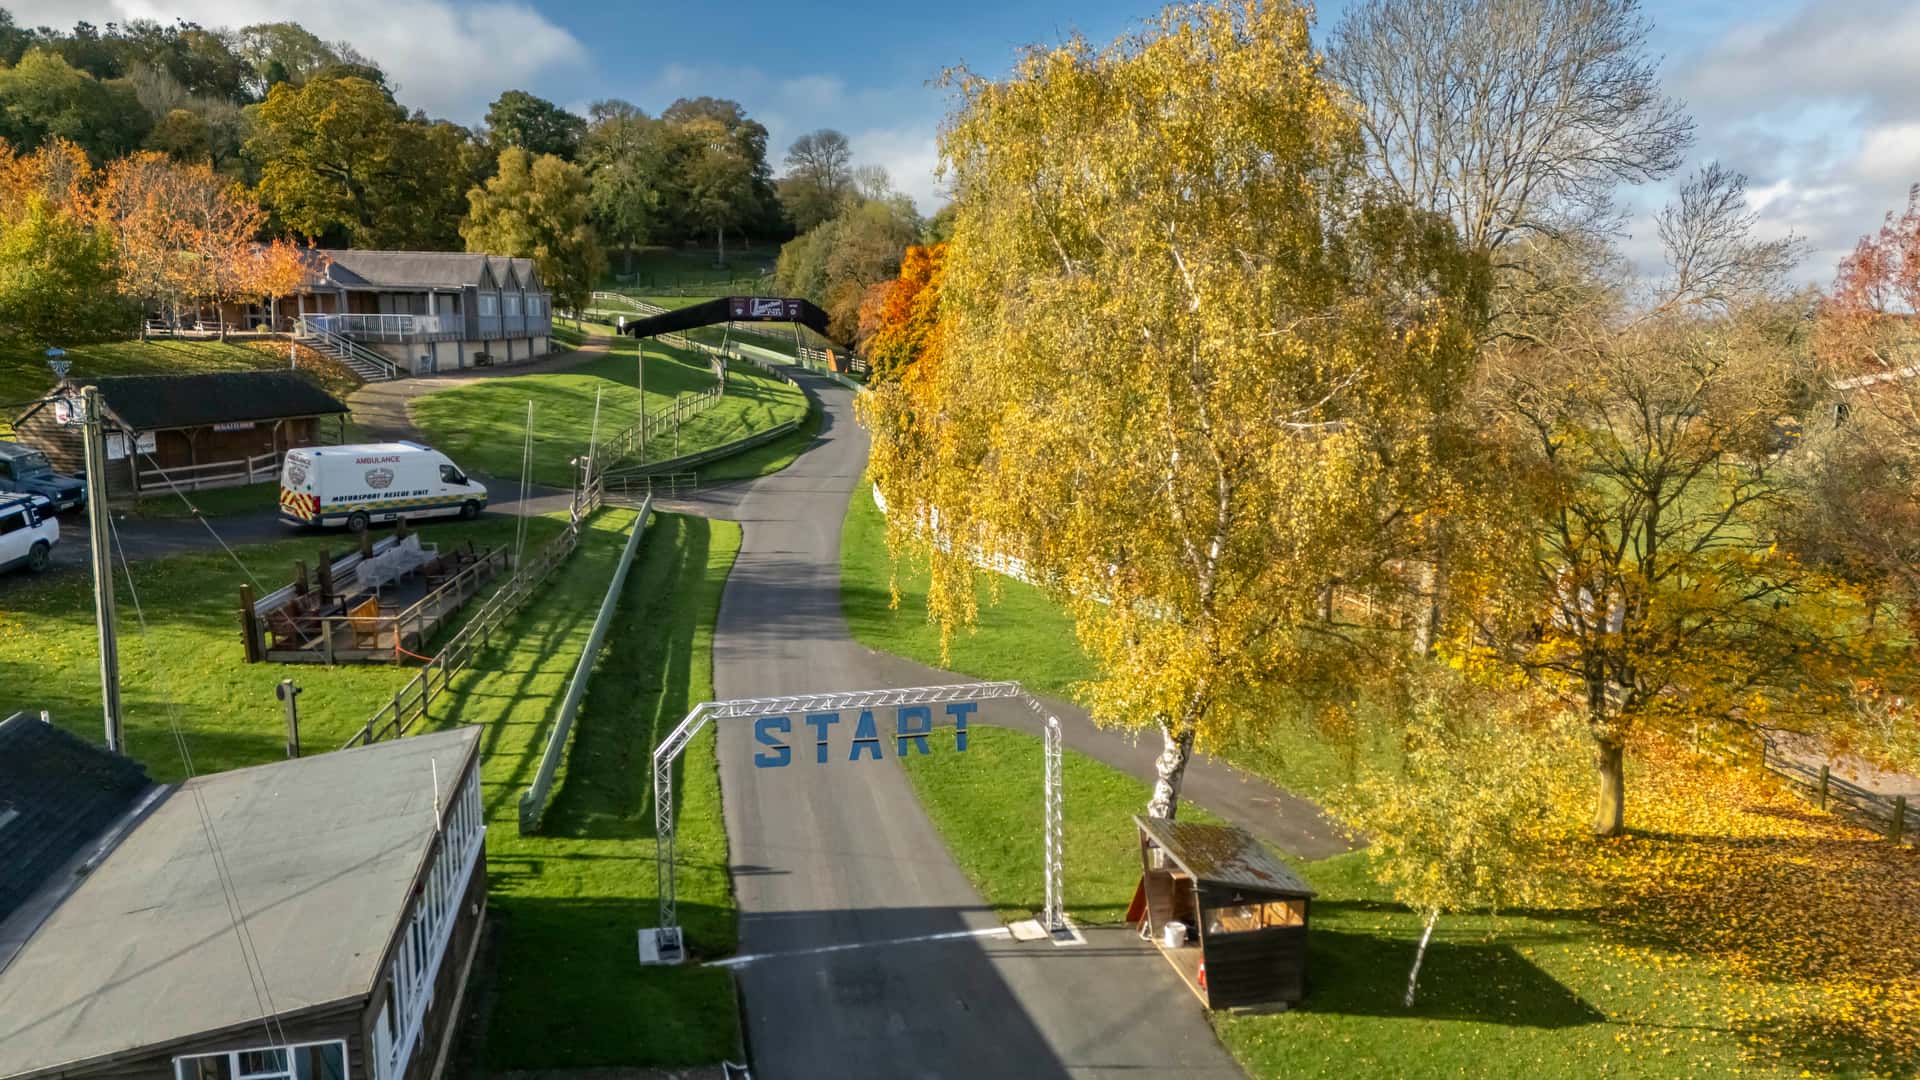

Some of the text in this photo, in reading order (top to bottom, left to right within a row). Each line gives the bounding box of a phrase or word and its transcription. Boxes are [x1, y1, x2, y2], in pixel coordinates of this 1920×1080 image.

[355, 456, 401, 465] AMBULANCE
[332, 493, 381, 502] MOTORSPORT
[384, 490, 410, 498] RESCUE
[754, 702, 978, 768] START
